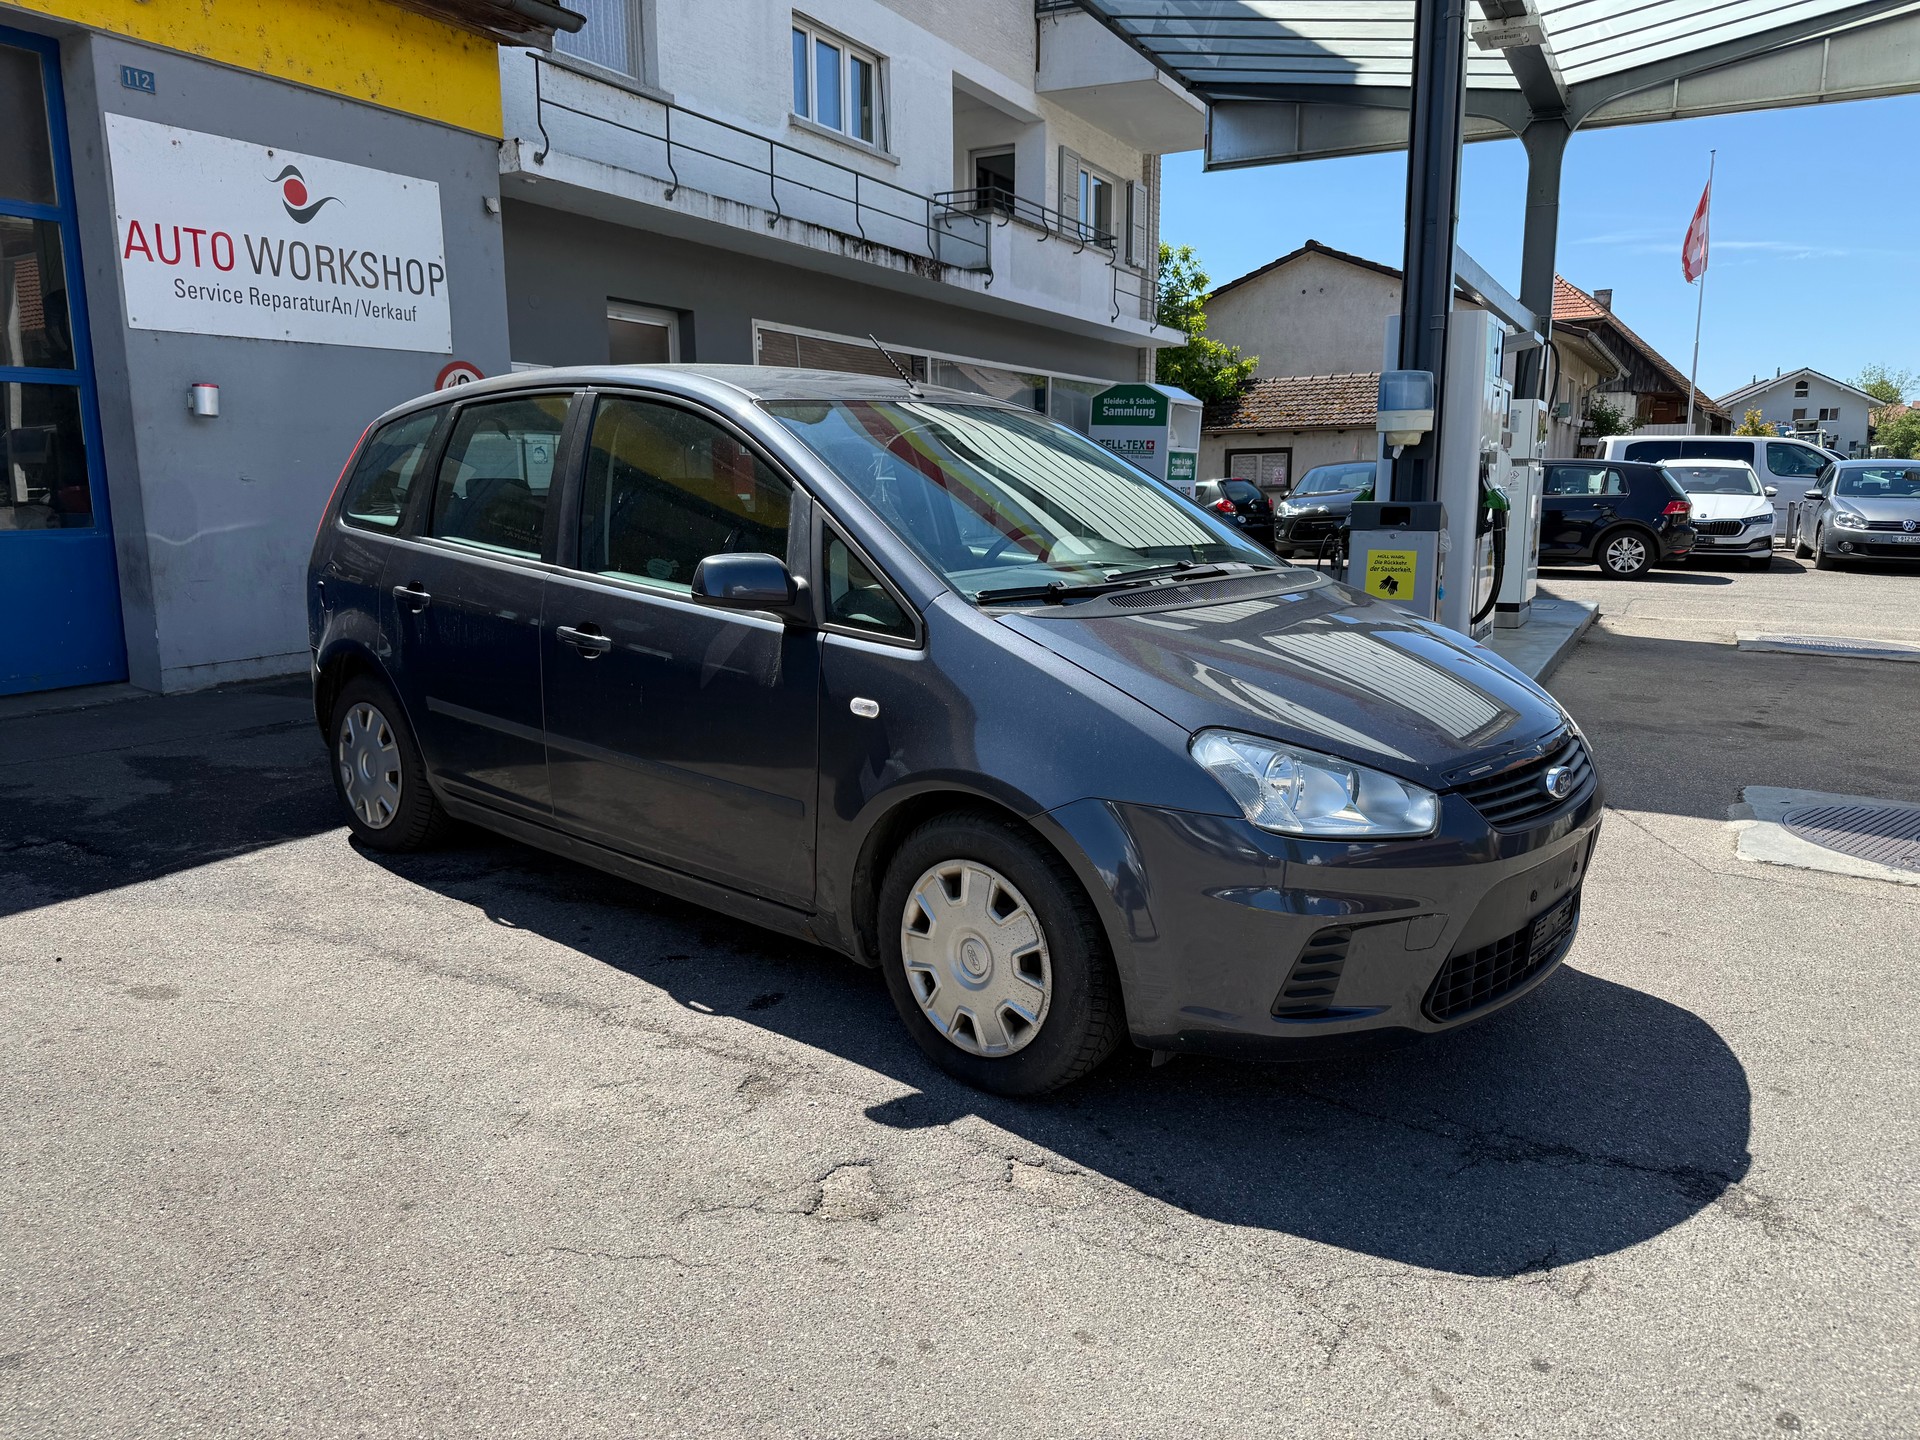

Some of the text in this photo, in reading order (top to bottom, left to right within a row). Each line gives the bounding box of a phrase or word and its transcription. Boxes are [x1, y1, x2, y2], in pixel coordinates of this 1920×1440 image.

[125, 69, 151, 89] 112
[124, 219, 445, 297] AUTO WORKSHOP
[174, 278, 243, 304] Service
[1103, 406, 1155, 418] Sammlung
